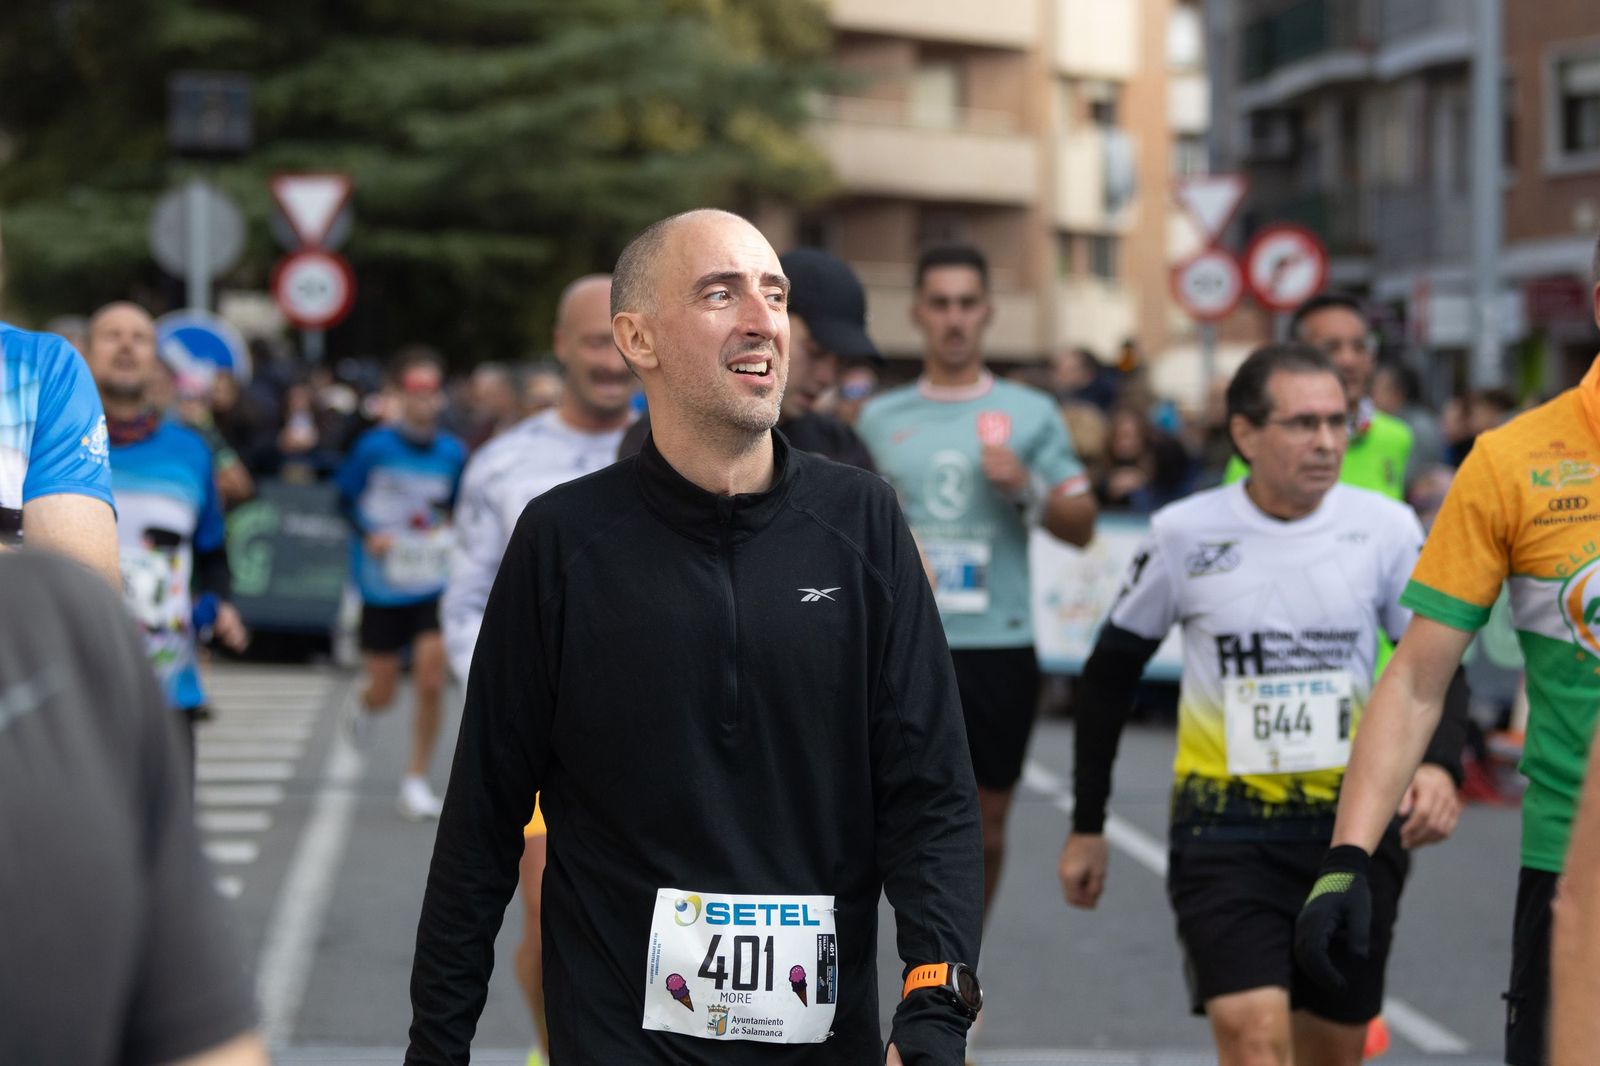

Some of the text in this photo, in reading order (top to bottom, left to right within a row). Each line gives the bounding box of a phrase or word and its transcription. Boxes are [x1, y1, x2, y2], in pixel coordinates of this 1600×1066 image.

[1259, 681, 1337, 697] SETEL
[1254, 702, 1312, 740] 644
[705, 902, 820, 926] SETEL
[697, 934, 774, 992] 401
[719, 992, 752, 1004] MORE
[731, 1016, 784, 1027] Ayuntamiento
[730, 1026, 783, 1037] de Salamanca
